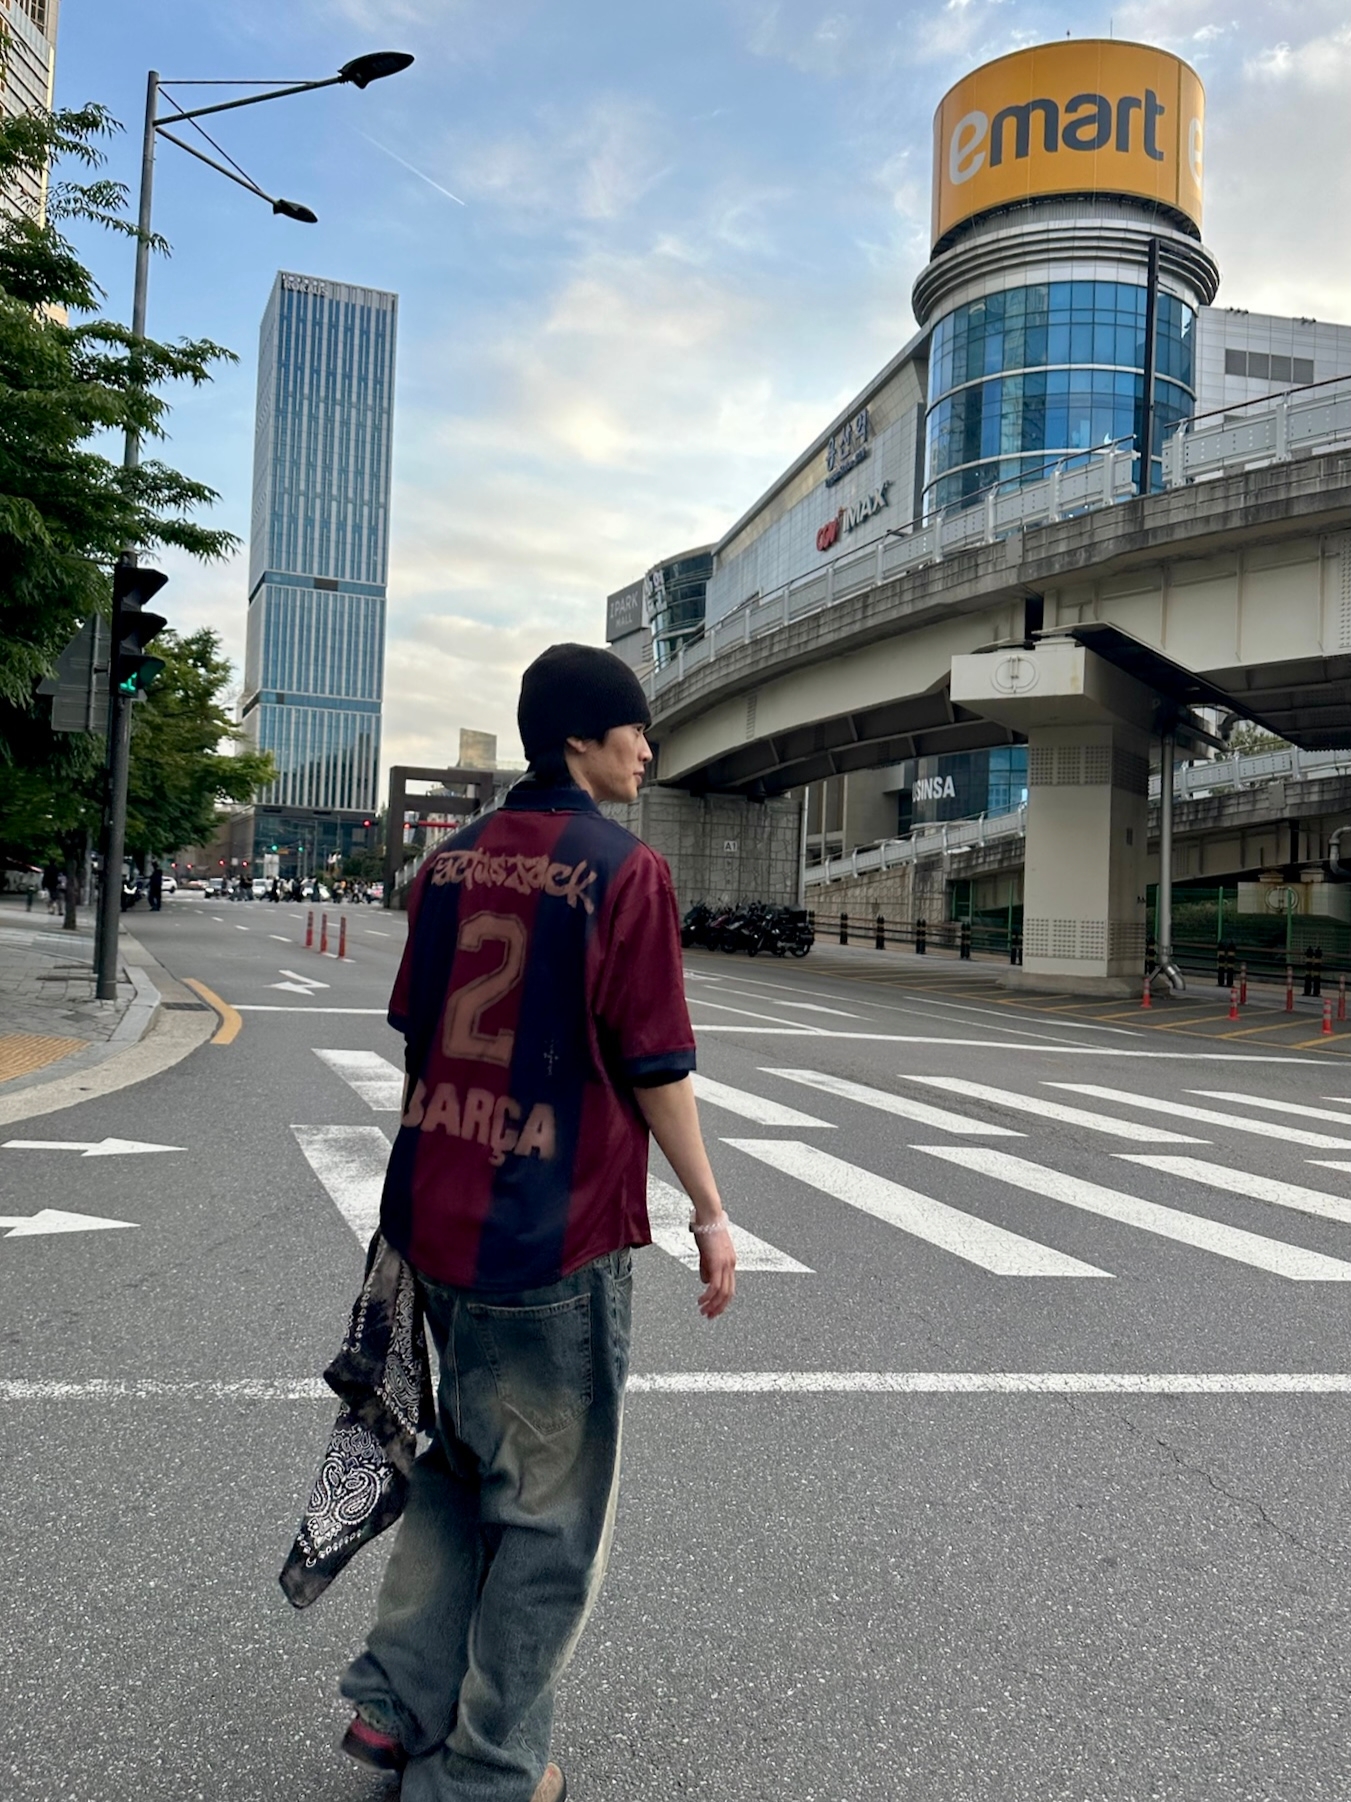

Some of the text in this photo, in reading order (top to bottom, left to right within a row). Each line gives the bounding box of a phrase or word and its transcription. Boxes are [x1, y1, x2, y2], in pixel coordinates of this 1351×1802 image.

[948, 88, 1165, 185] emart
[826, 407, 869, 472] 용산역
[842, 480, 891, 534] IMAX
[610, 590, 639, 620] IPARK
[615, 612, 633, 628] MALL
[725, 841, 736, 851] A1
[442, 910, 528, 1069] 2
